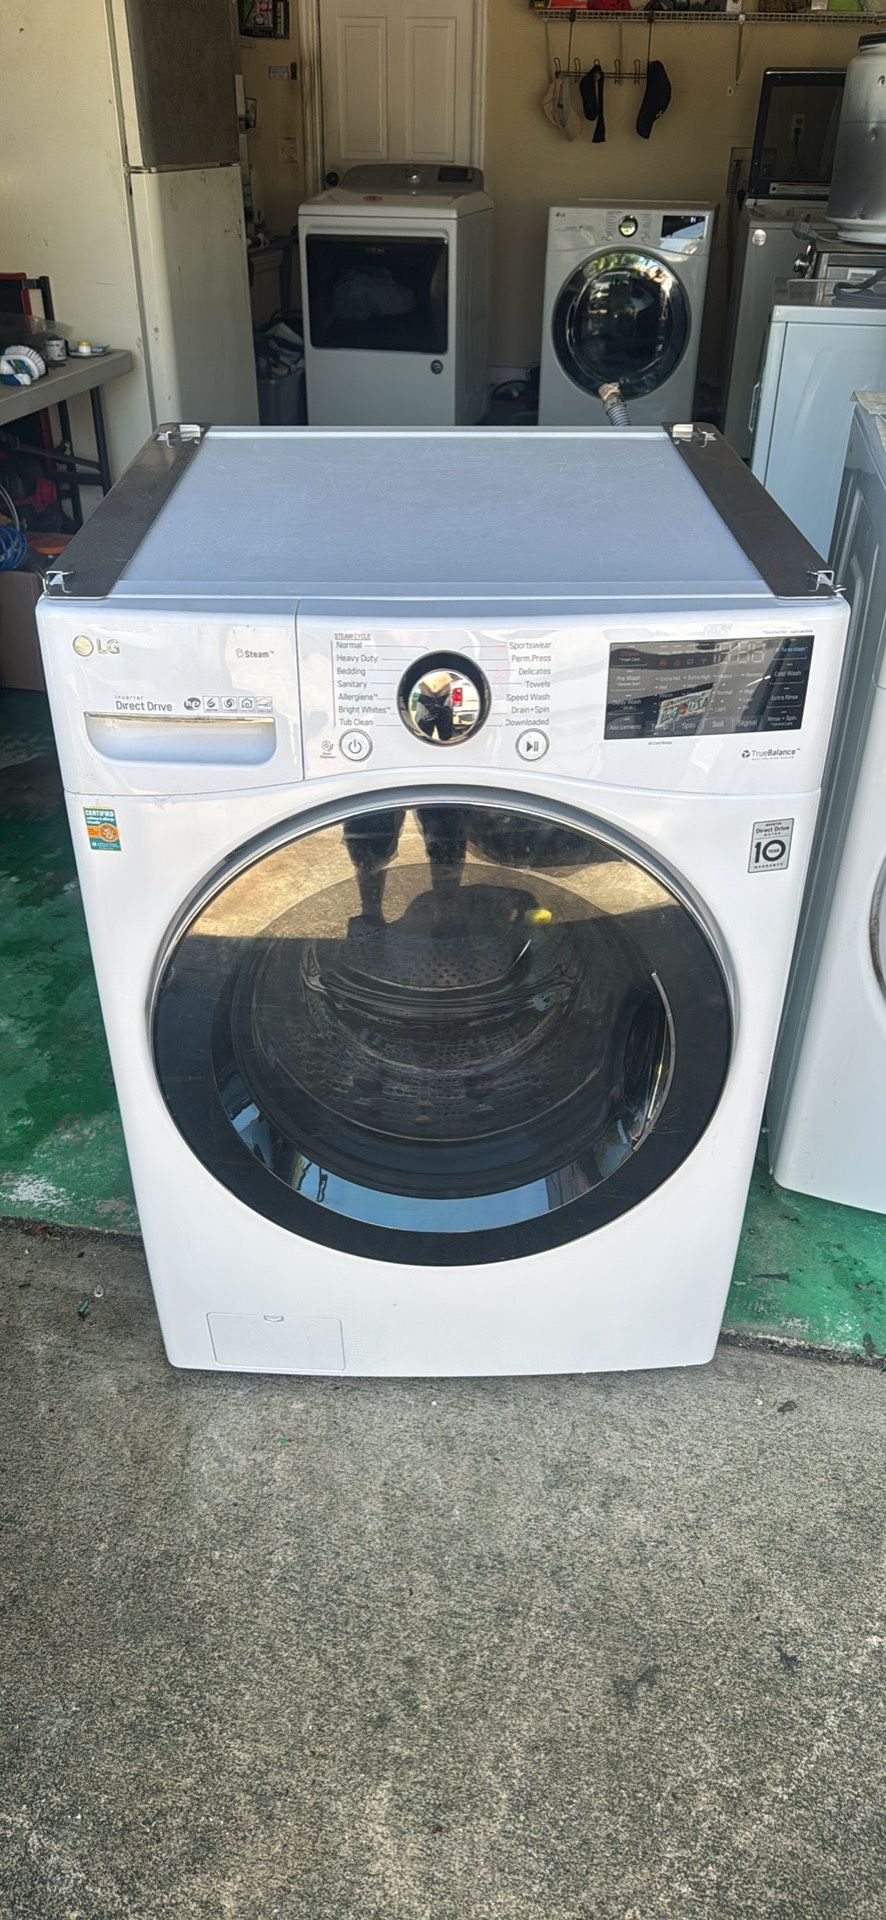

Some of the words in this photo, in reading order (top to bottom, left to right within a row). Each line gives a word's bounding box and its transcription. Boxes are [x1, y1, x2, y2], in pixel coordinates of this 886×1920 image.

[96, 639, 120, 654] LG
[336, 641, 362, 649] Normal
[509, 641, 552, 651] Sportswear
[336, 654, 359, 664] Heavy
[360, 654, 378, 664] Duty
[336, 667, 366, 676] Bedding
[518, 667, 551, 676] Delicates
[337, 680, 367, 689] Sanitary
[524, 680, 551, 688] Towels
[506, 693, 529, 702] Speed
[530, 693, 551, 701] Wash
[115, 700, 145, 710] Direct
[146, 701, 173, 711] Drive
[338, 705, 360, 714] Bright
[340, 718, 352, 726] Tub
[353, 718, 374, 726] Clean
[505, 718, 550, 726] Downloaded
[681, 721, 696, 731] Spin
[737, 718, 757, 727] Signal
[754, 839, 786, 863] 10
